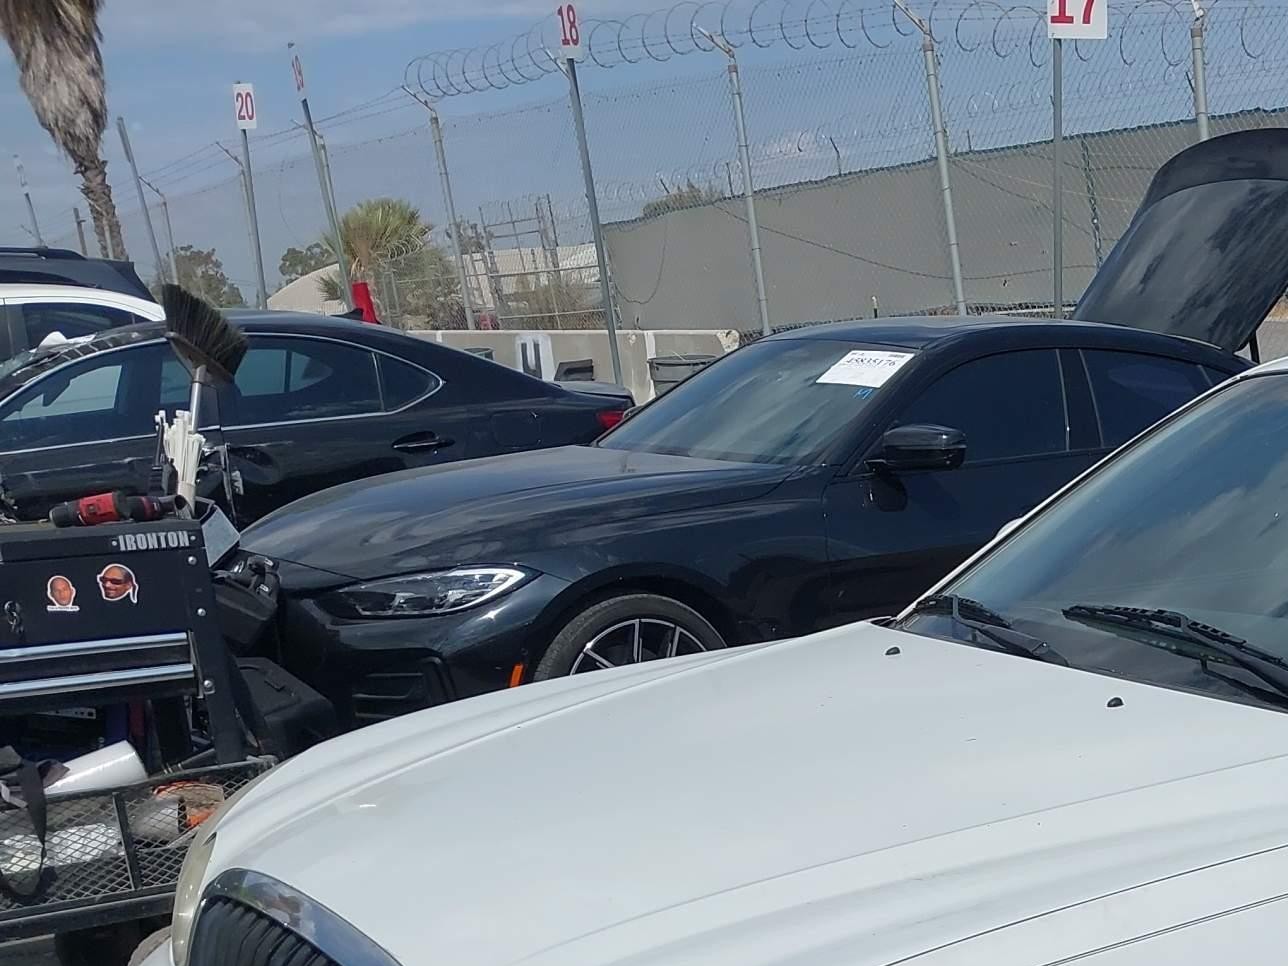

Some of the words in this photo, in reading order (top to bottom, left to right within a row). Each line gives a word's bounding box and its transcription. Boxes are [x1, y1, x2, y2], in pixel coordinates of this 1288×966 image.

[557, 4, 579, 46] 18
[291, 55, 304, 91] 19
[236, 92, 254, 121] 20
[119, 530, 189, 551] IRONTON
